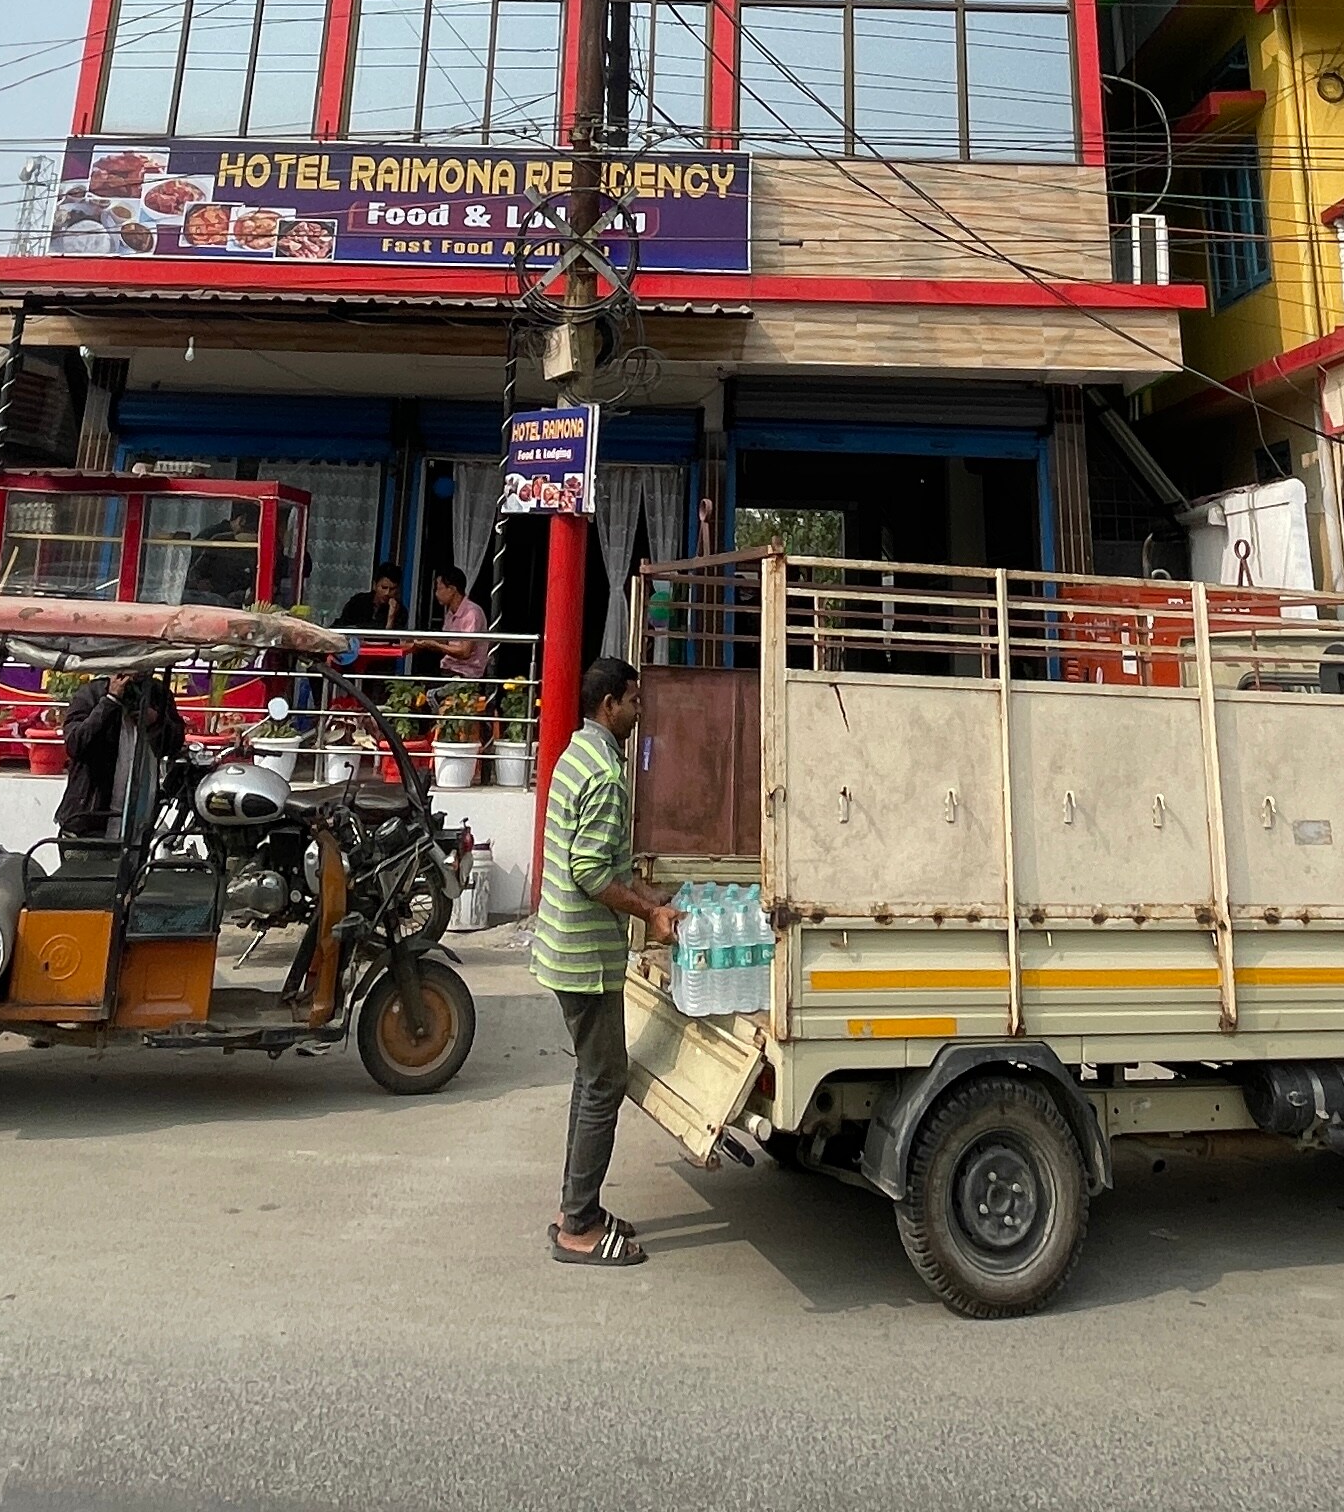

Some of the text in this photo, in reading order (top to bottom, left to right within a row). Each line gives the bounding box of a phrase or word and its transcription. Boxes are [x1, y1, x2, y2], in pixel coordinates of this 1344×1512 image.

[217, 152, 735, 200] HOTEL RAIMONA REIDENCY
[367, 201, 450, 226] Food
[463, 204, 491, 228] &
[382, 238, 432, 254] Fast
[441, 239, 493, 256] Food
[511, 417, 585, 442] HOTEL RAIMONA
[517, 449, 535, 461] Food
[543, 447, 572, 460] Lodging
